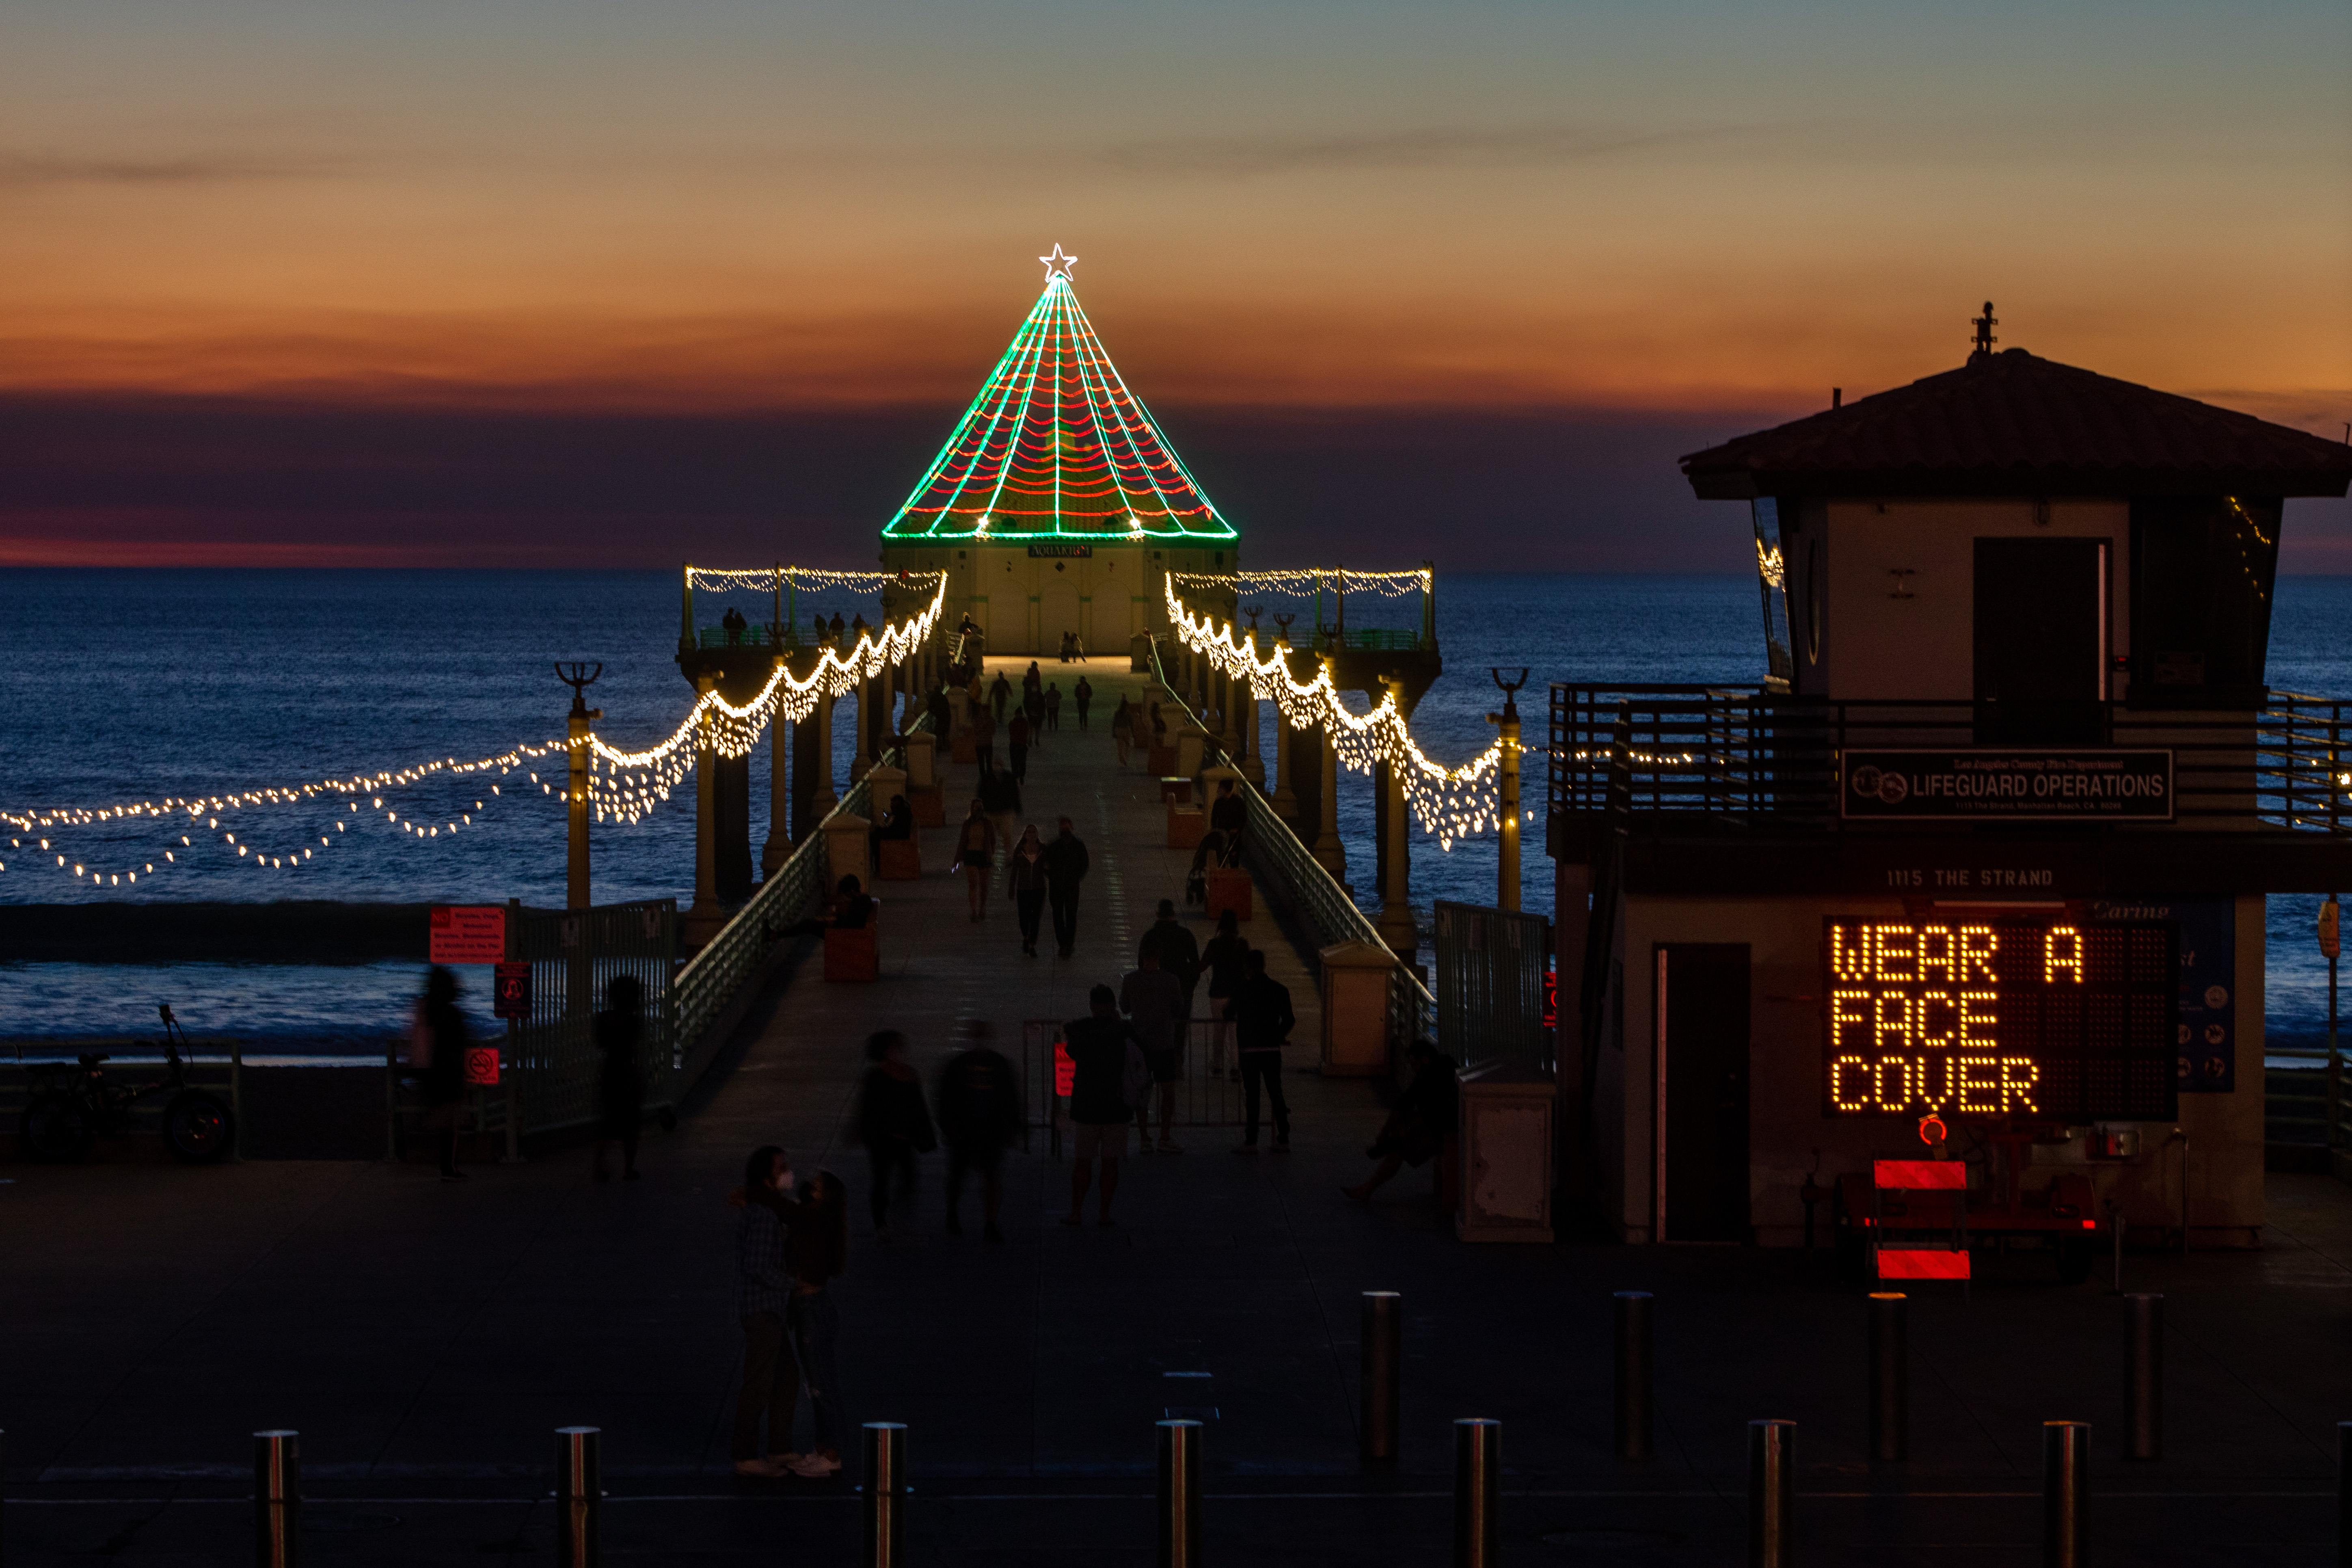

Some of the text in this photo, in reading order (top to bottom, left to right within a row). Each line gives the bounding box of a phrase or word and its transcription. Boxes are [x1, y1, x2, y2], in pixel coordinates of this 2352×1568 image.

[1031, 545, 1090, 556] AQUARIUM
[1912, 773, 2164, 797] LIFEGUARD OPERATIONS
[1974, 801, 1988, 810] The
[1887, 869, 2053, 886] 1115 THE STRAND
[432, 912, 449, 923] NO
[2093, 899, 2171, 920] Caring
[1833, 925, 2082, 983] WEAR A
[1833, 990, 1997, 1047] FACE
[1832, 1055, 2039, 1112] COVER
